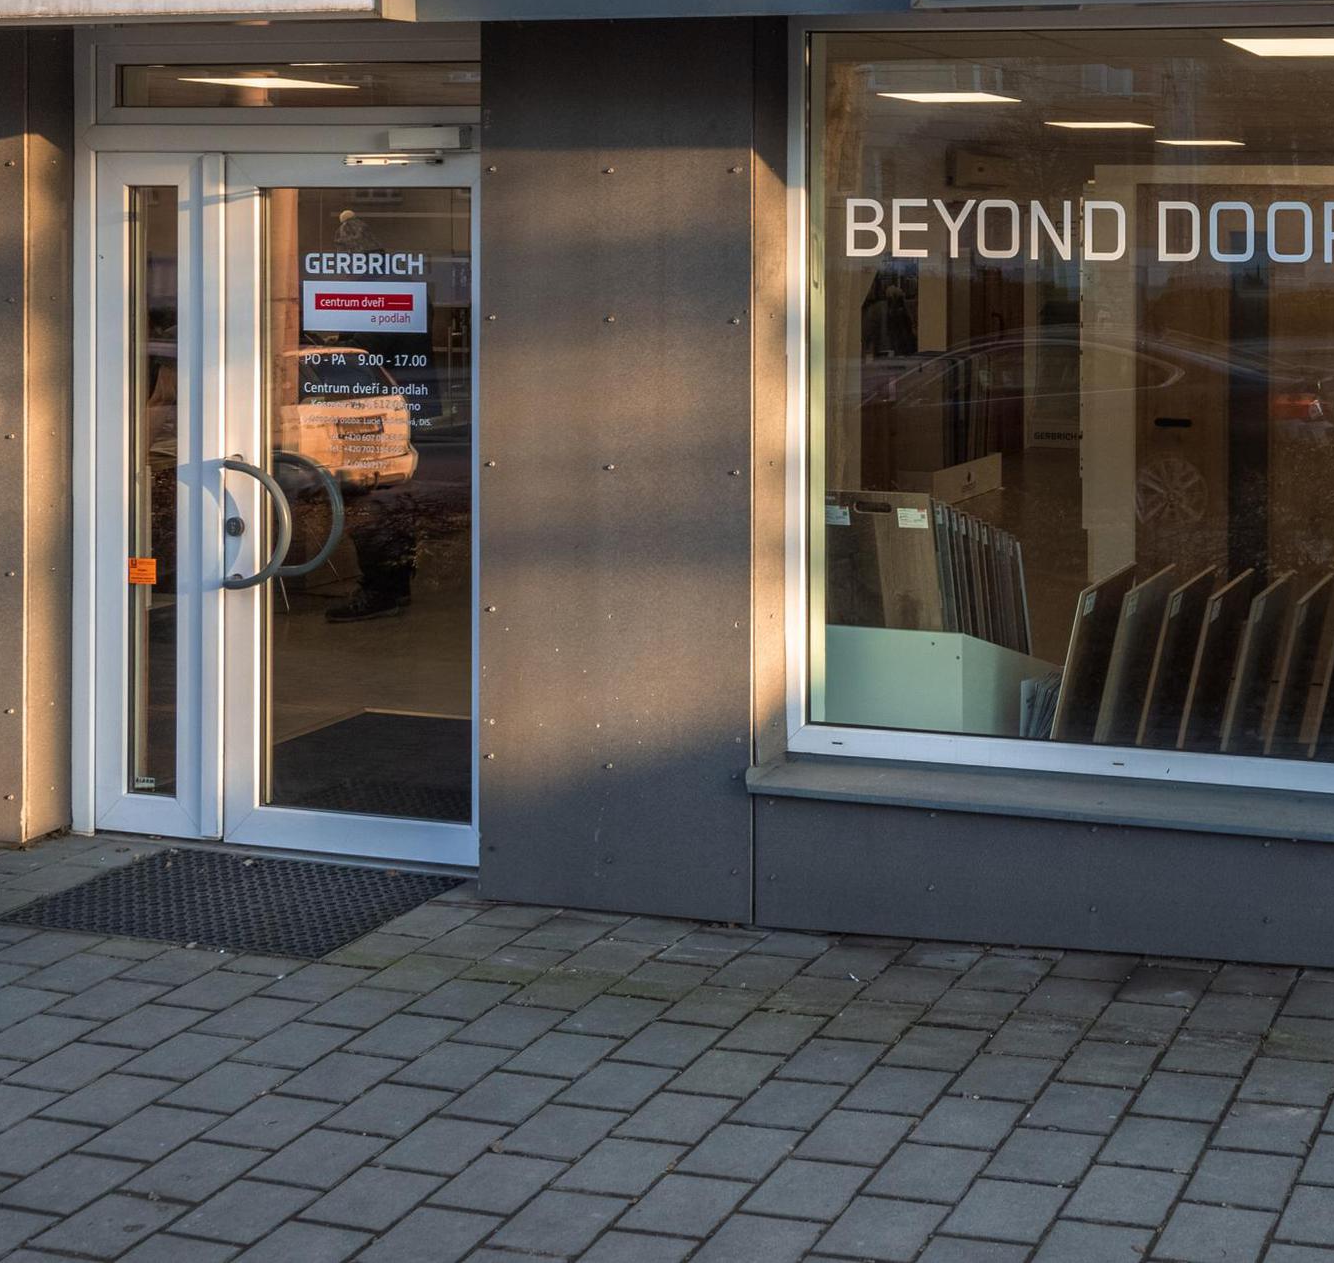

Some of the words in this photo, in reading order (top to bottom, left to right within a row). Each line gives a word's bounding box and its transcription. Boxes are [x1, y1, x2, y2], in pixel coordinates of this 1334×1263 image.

[845, 198, 1126, 262] BEYOND
[305, 252, 424, 275] GERBRICH
[320, 298, 359, 307] centrum
[362, 296, 385, 308] dveří
[370, 315, 376, 323] a
[378, 312, 411, 325] podlah
[304, 353, 321, 365] PO
[331, 353, 347, 366] PA
[357, 353, 384, 367] 9.00
[394, 354, 427, 367] 17.00
[303, 381, 350, 394] Centrum
[352, 382, 380, 394] dveří
[382, 385, 388, 395] a
[391, 384, 429, 399] podlah
